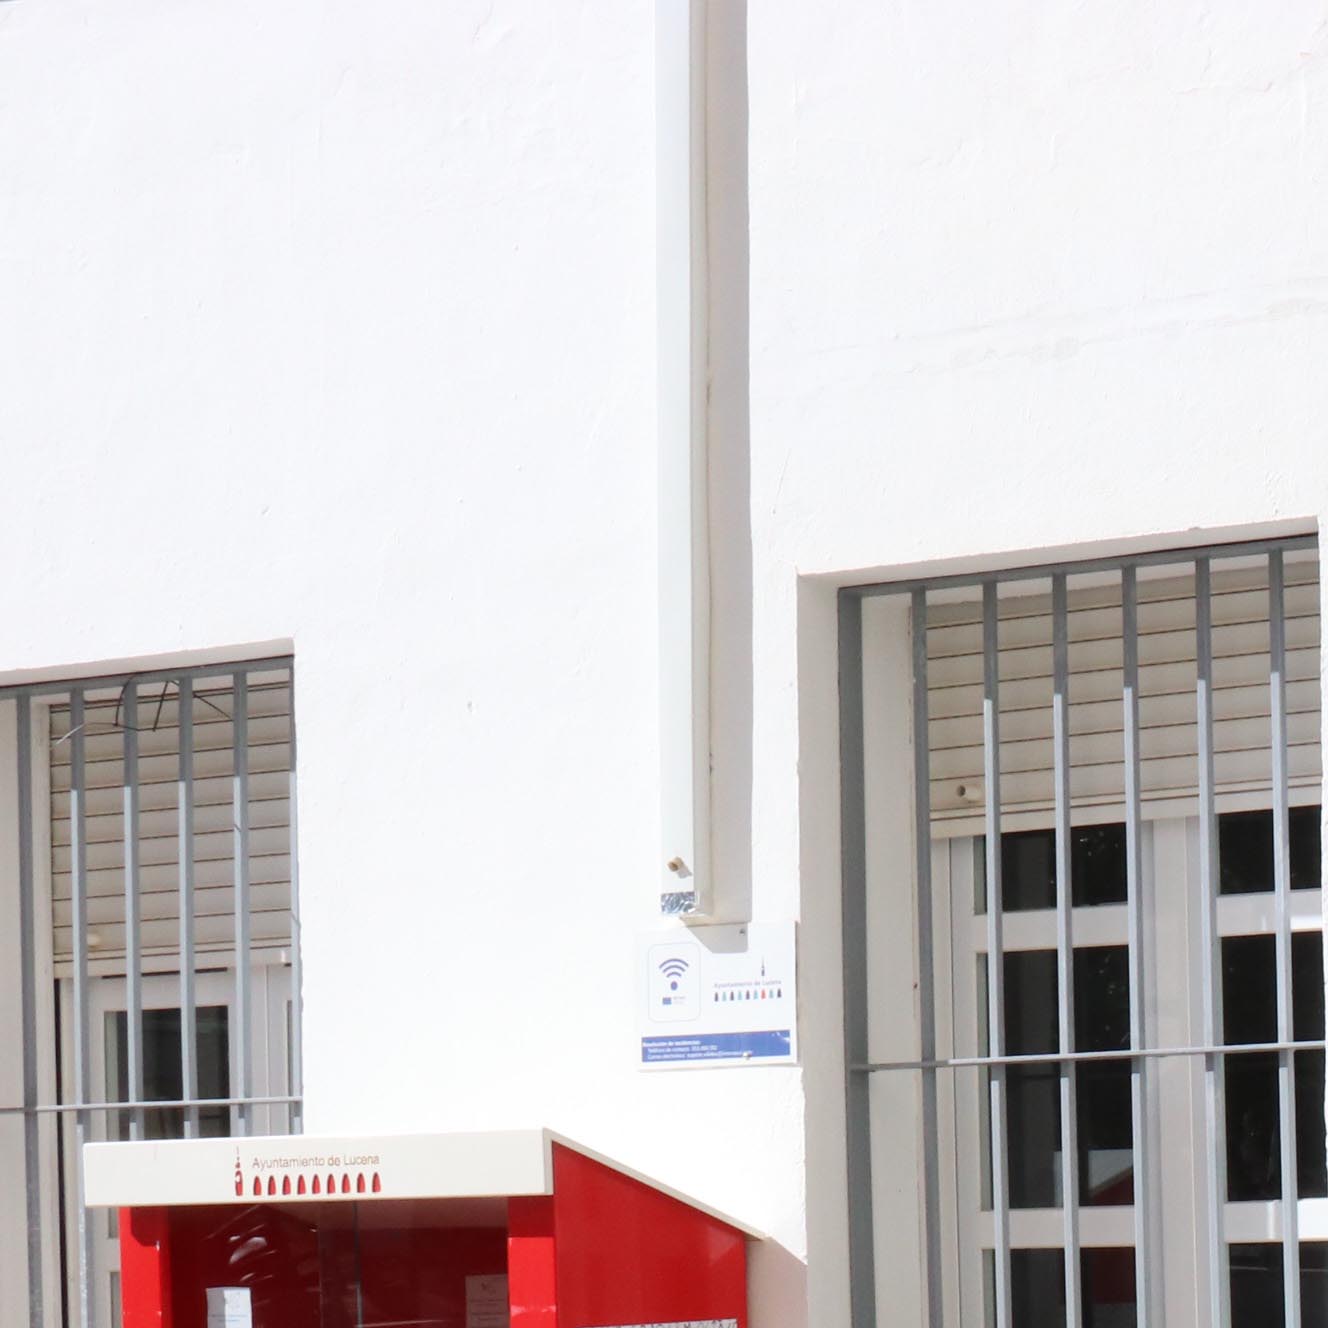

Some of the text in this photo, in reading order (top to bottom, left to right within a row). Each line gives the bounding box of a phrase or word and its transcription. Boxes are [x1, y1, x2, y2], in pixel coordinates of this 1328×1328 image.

[252, 1155, 380, 1171] Ayuntamiento de Lucena
